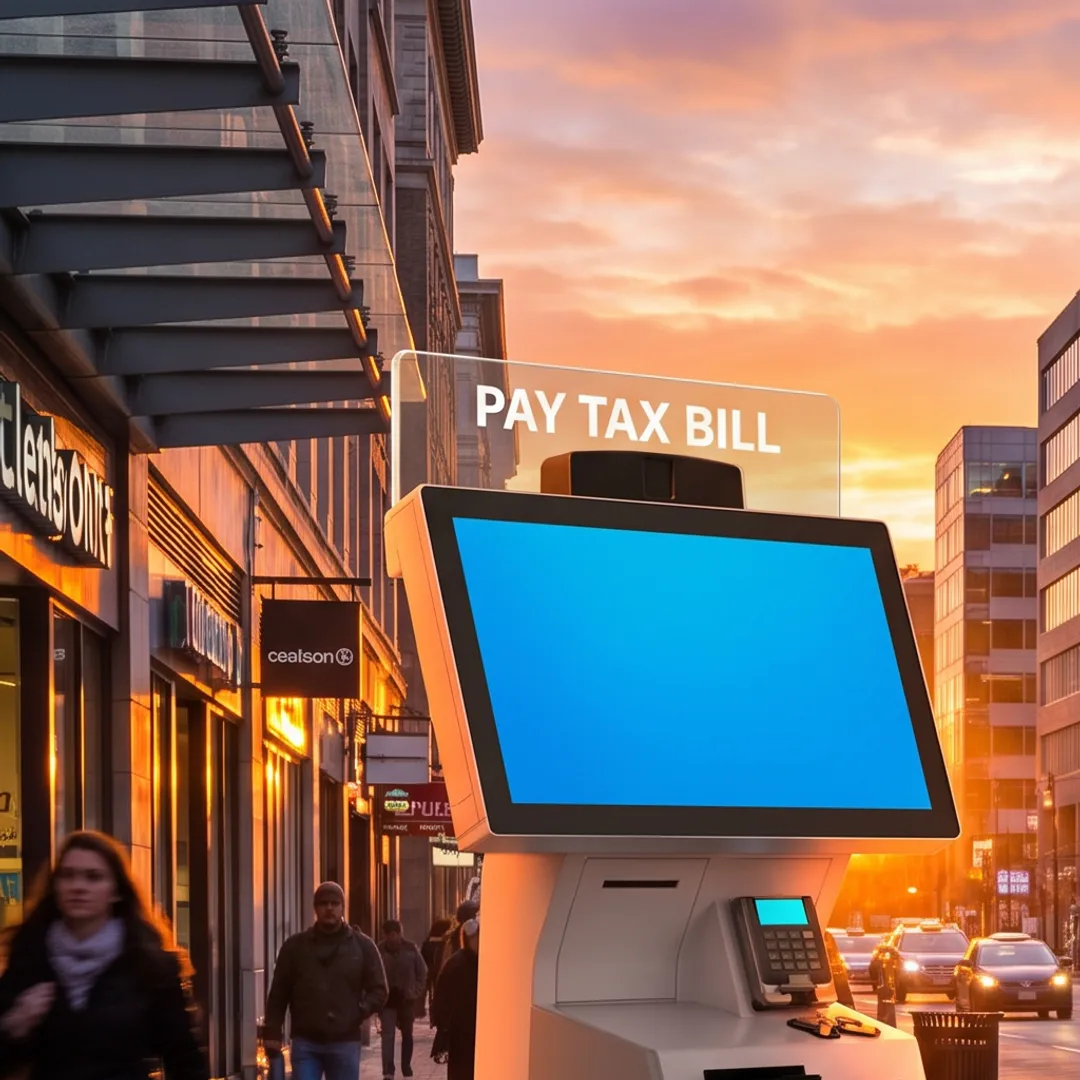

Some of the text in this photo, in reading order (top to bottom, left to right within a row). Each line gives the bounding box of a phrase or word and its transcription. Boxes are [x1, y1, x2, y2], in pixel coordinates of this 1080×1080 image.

[476, 385, 781, 454] PAY TAX BILL
